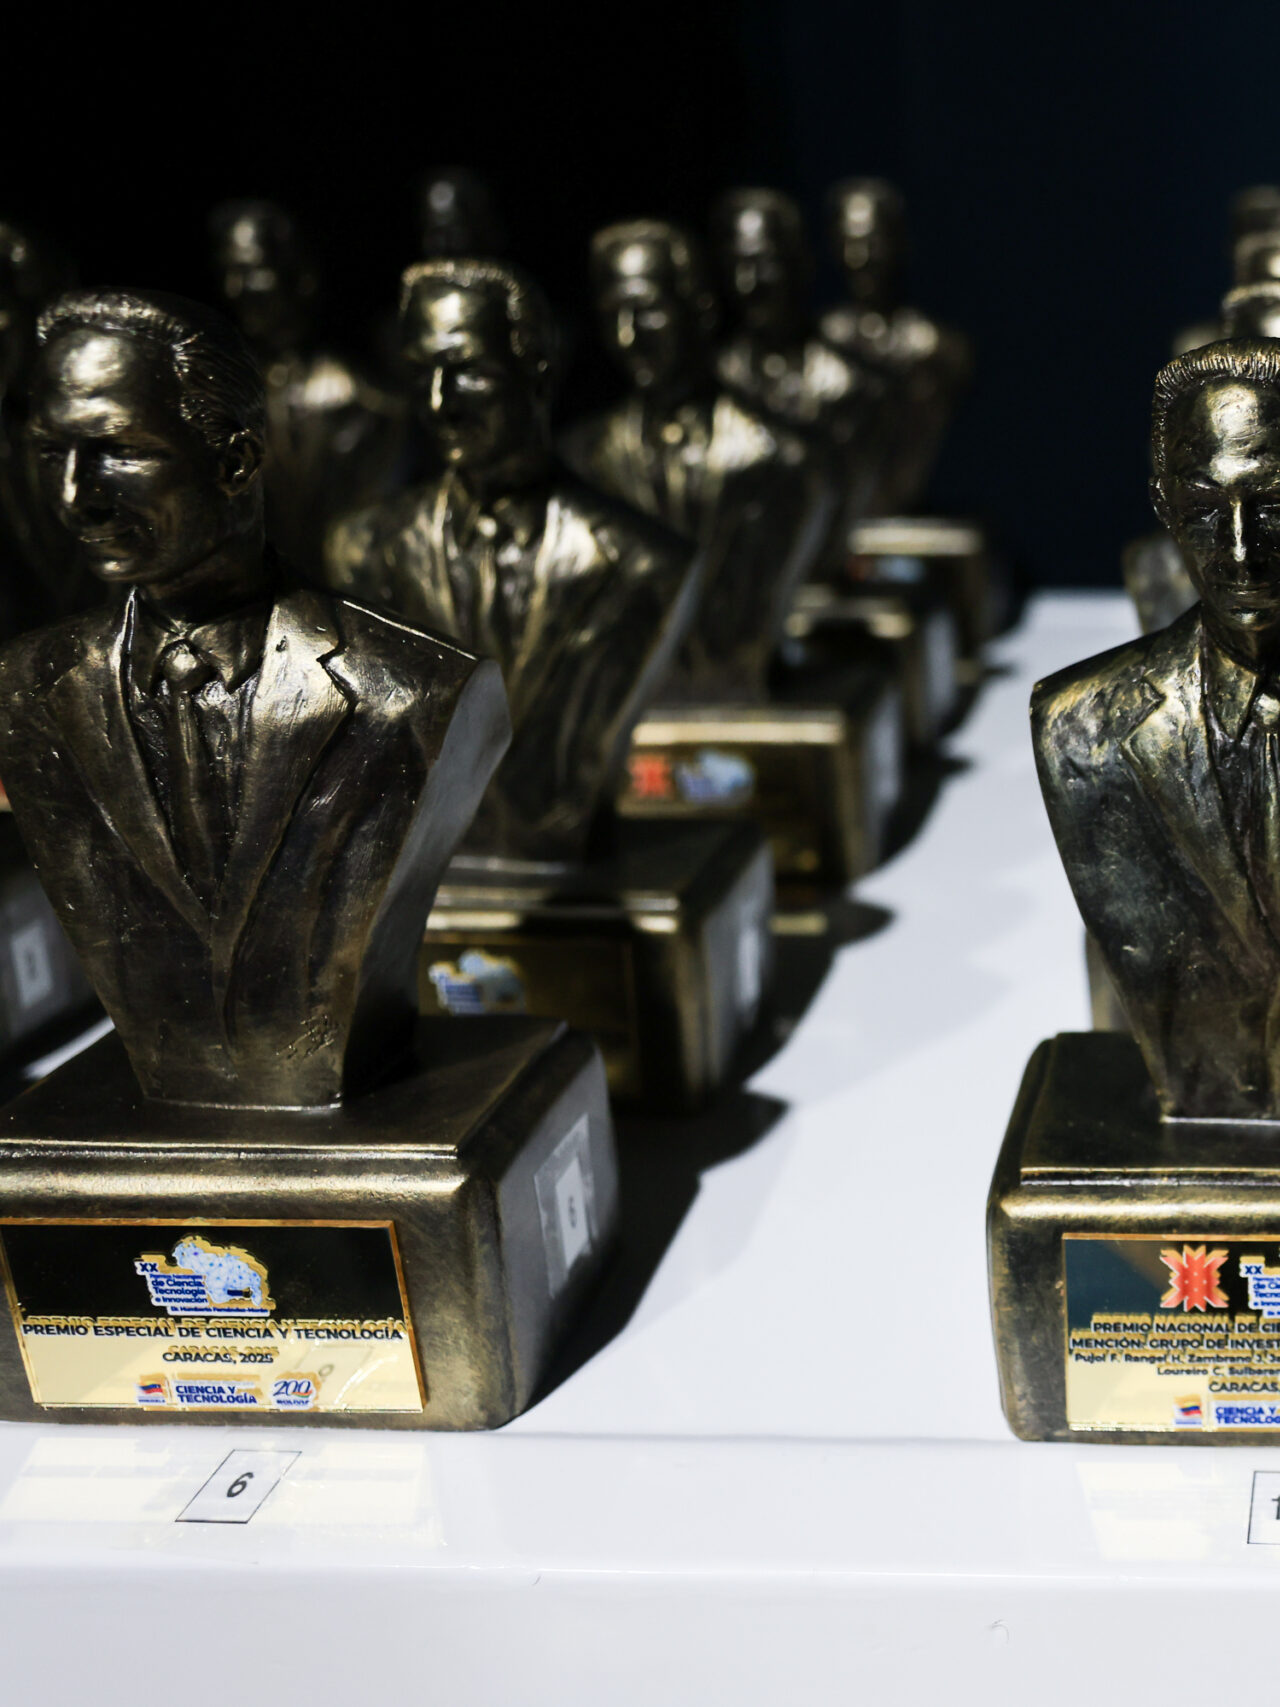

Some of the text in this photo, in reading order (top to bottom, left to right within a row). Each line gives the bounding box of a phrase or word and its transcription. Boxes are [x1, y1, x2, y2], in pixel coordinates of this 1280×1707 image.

[139, 1262, 158, 1272] XX
[152, 1279, 165, 1287] de
[22, 1324, 404, 1340] PREMIO ESPECIAL DE CIENCIA Y TECNOLOGÍA
[1093, 1322, 1151, 1333] PREMIO
[1155, 1322, 1231, 1333] NACIONAL
[1237, 1322, 1259, 1333] DE
[1149, 1339, 1202, 1349] GRUPO
[1206, 1339, 1225, 1349] DE
[162, 1352, 274, 1364] CARACAS, 2025
[1074, 1353, 1106, 1364] Pujol
[1124, 1353, 1167, 1364] Rangel
[1157, 1367, 1209, 1376] Loureiro
[175, 1385, 237, 1394] CIENCIA Y
[177, 1393, 257, 1404] TECNOLOGÍA
[1215, 1406, 1277, 1415] CIENCIA Y
[226, 1471, 255, 1498] 6
